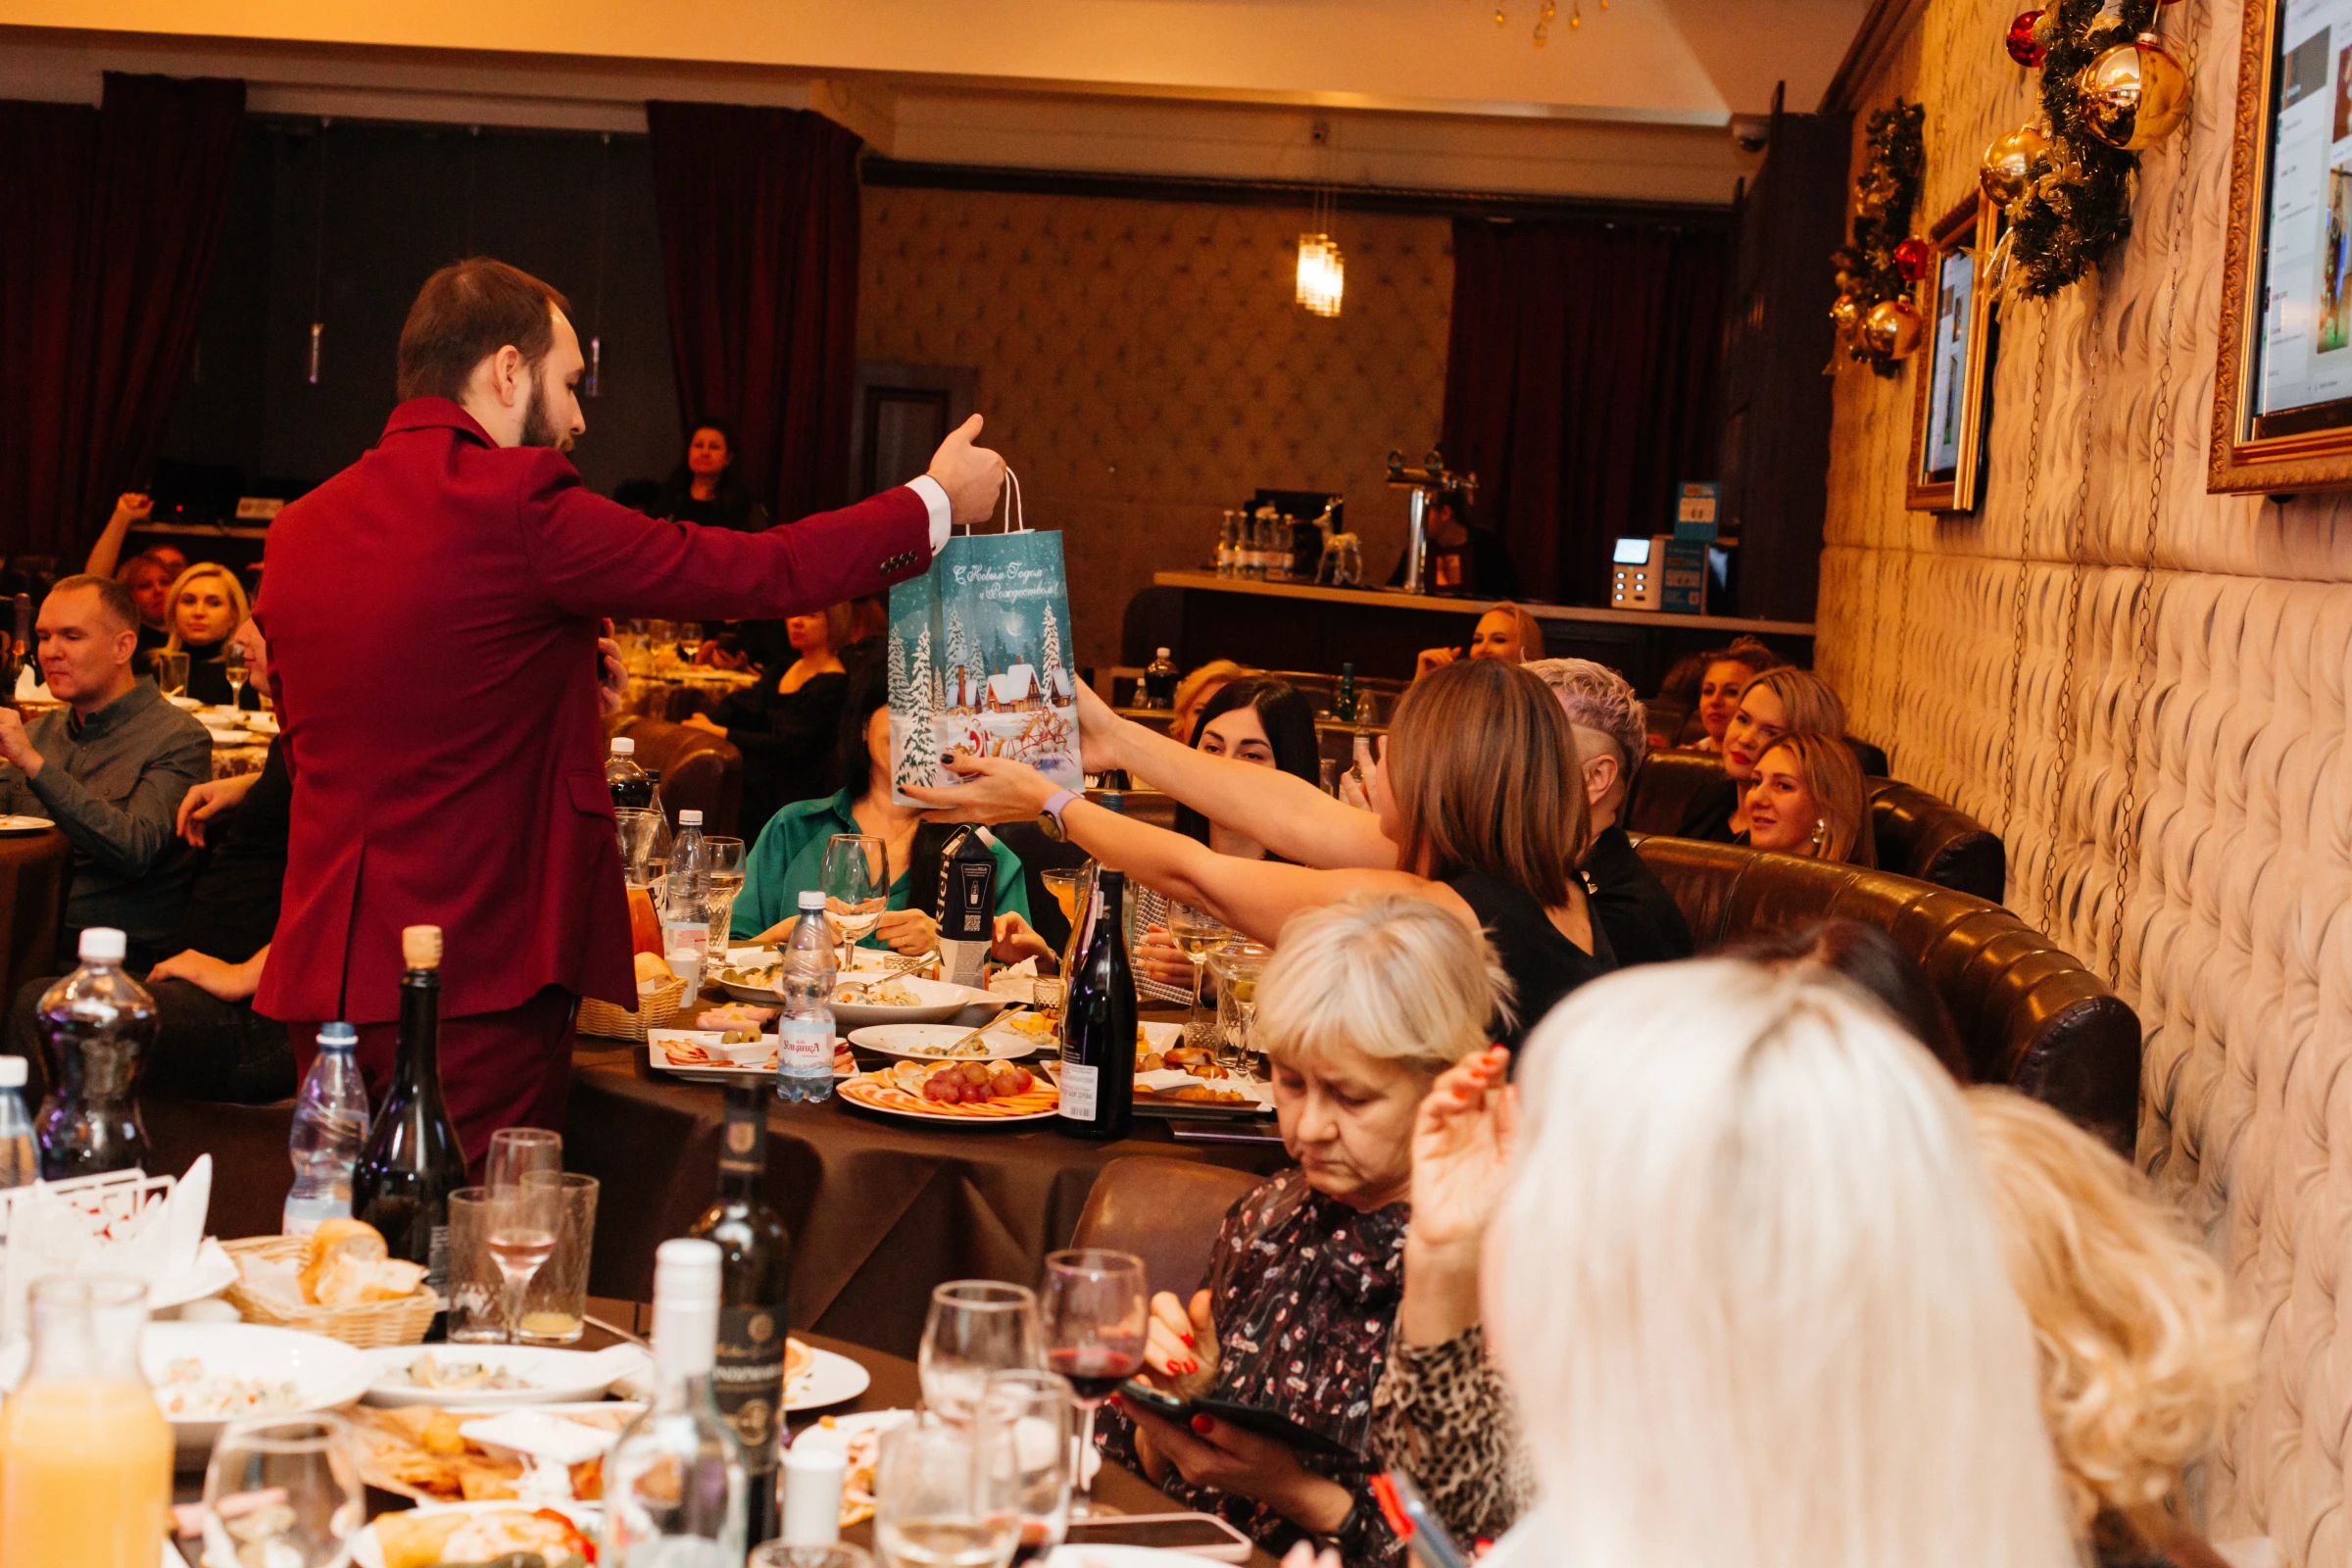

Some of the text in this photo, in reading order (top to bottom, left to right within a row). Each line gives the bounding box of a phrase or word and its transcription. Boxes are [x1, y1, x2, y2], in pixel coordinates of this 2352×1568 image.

[953, 562, 1044, 585] С Новым Годом
